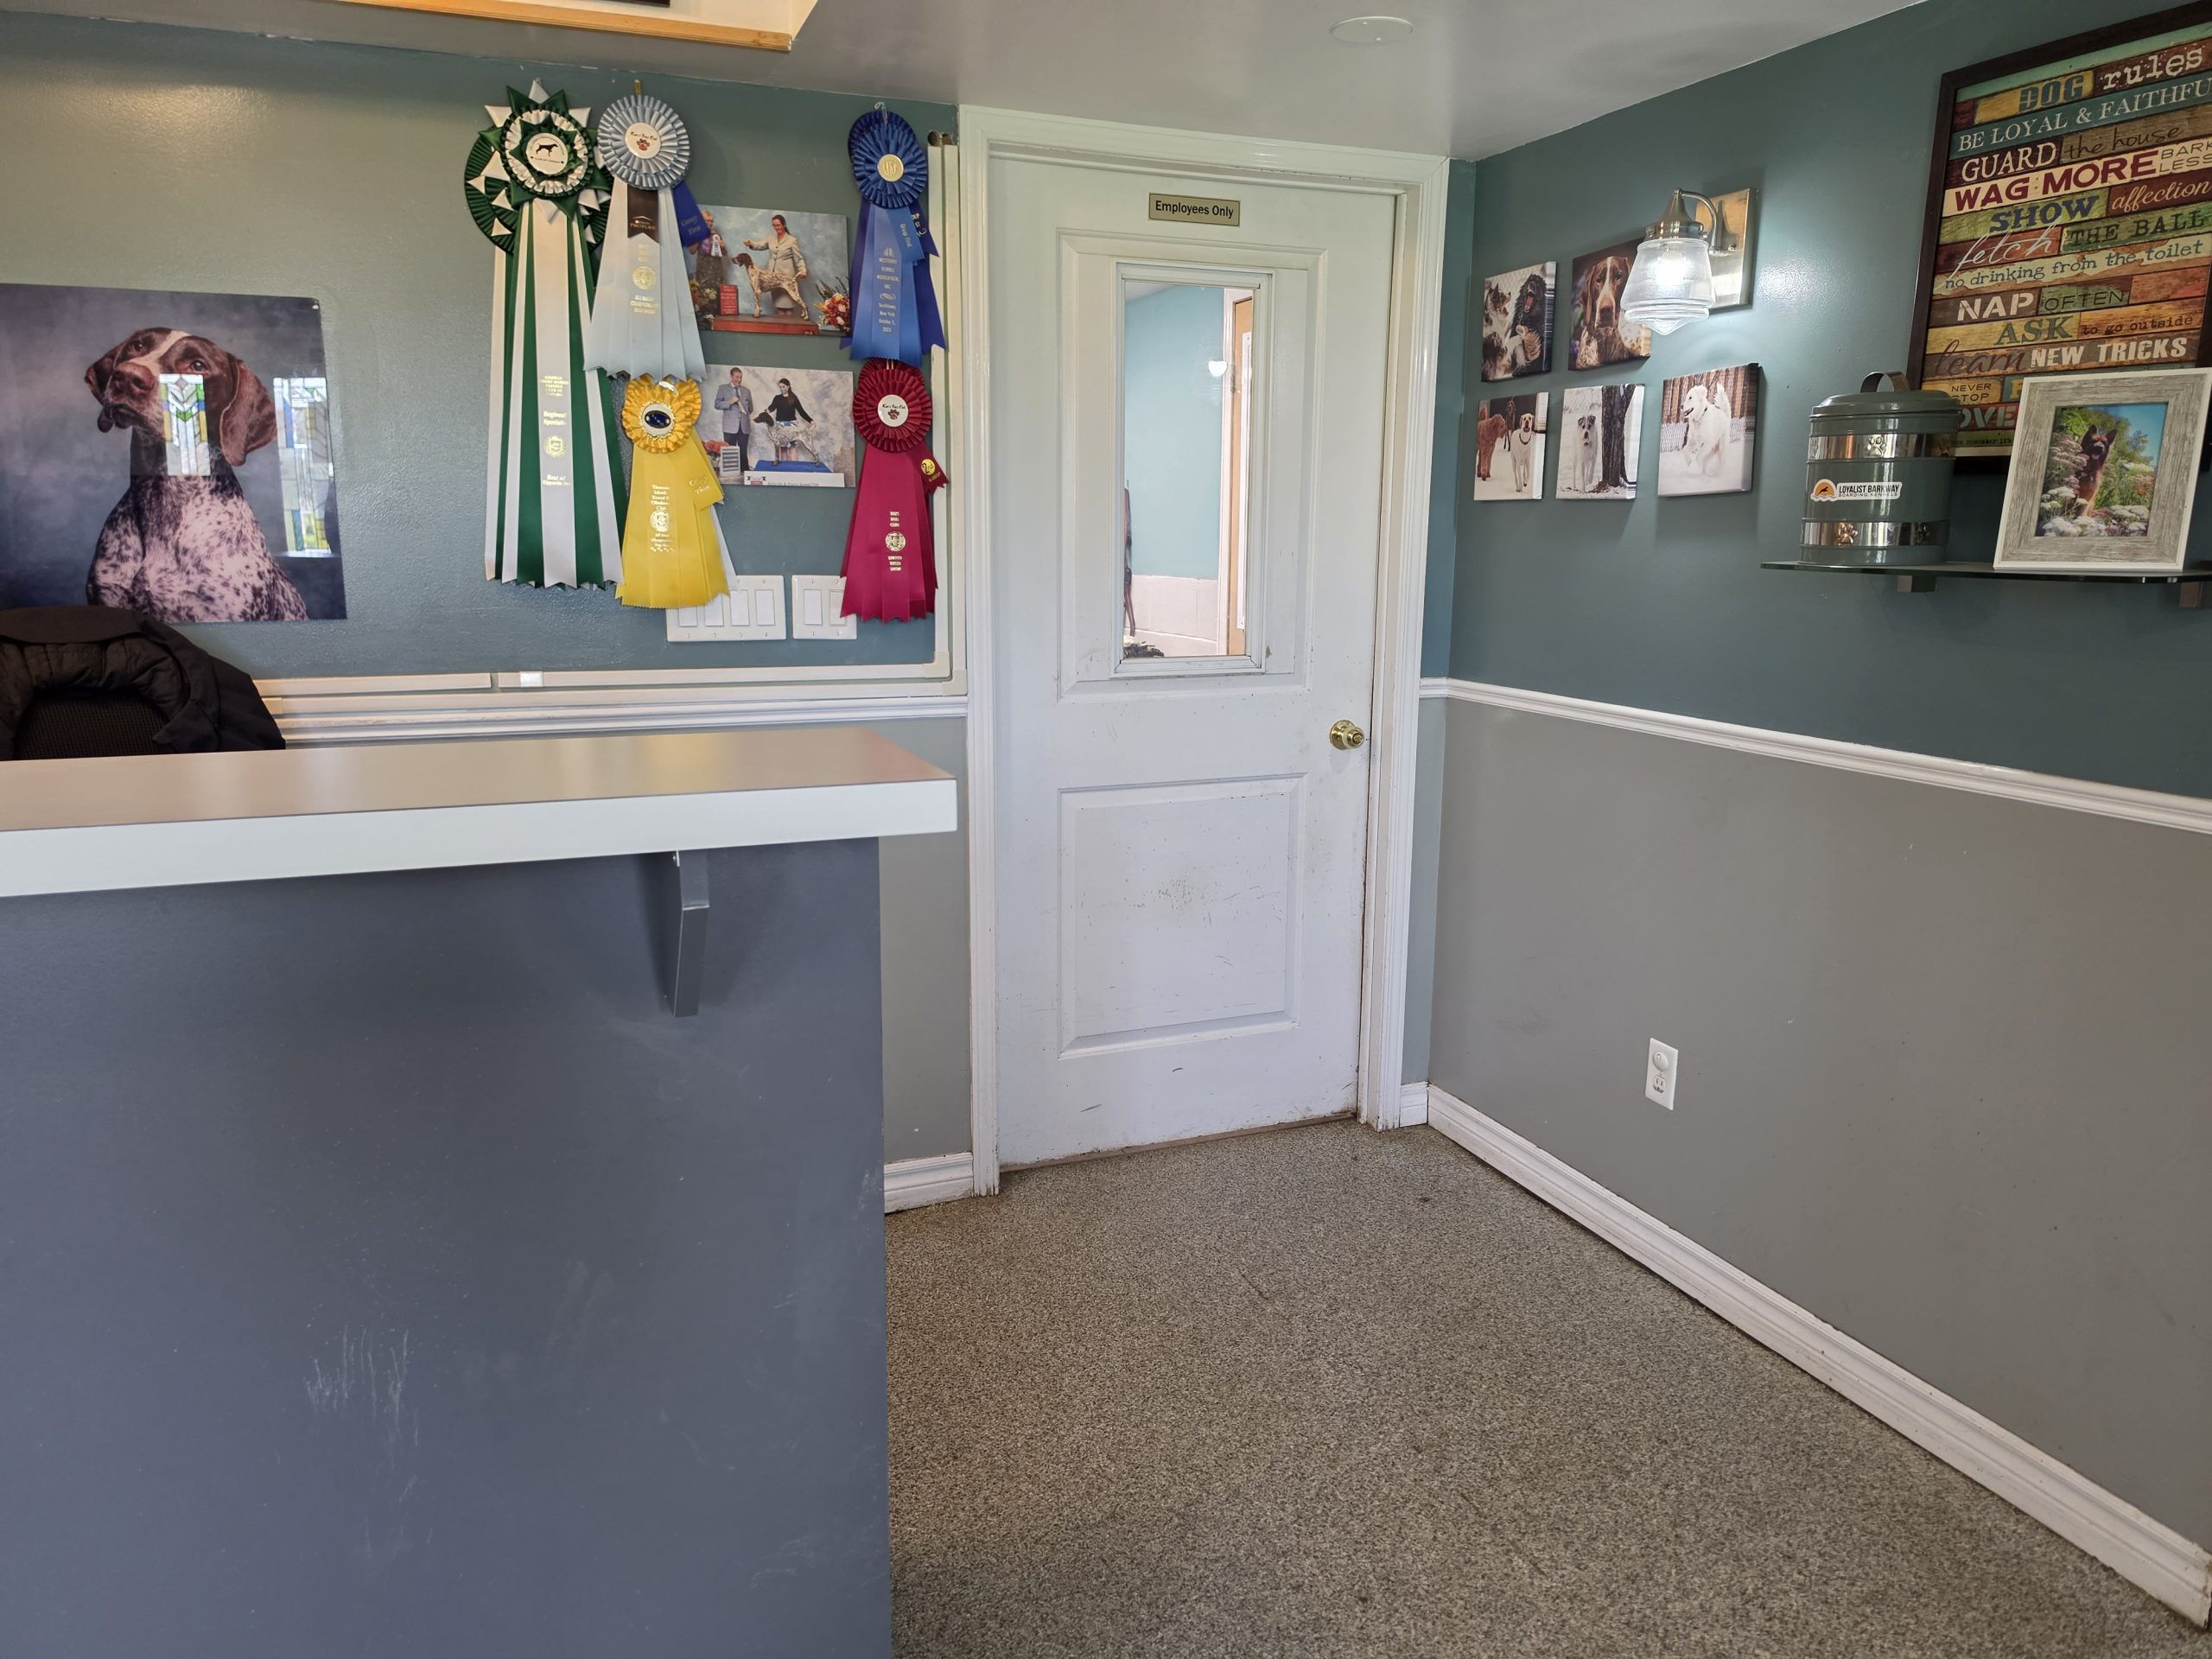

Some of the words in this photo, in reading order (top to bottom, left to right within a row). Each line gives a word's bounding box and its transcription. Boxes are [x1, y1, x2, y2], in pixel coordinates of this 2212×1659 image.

[2018, 74, 2084, 112] DOG
[2101, 47, 2203, 90] rules
[1959, 131, 1985, 152] BE
[1991, 113, 2069, 143] LOYAL
[2075, 107, 2092, 124] &
[1961, 141, 2056, 182] GUARD
[2064, 136, 2103, 162] the
[2111, 127, 2184, 151] house
[2160, 156, 2212, 173] LESS
[1955, 177, 2030, 212] WAG
[2042, 149, 2159, 197] MORE
[1155, 200, 1210, 216] Employees
[1211, 205, 1234, 219] Only
[1990, 195, 2100, 232] SHOW
[2112, 180, 2212, 213] affection
[1944, 276, 1965, 290] no
[1970, 264, 2045, 286] drinking
[2052, 258, 2098, 279] from
[2105, 246, 2138, 266] the
[2145, 238, 2203, 261] toilet
[1946, 214, 2058, 282] fetch
[2067, 219, 2120, 245] THE
[2133, 210, 2205, 238] BALL
[1957, 292, 2034, 321] NAP
[2044, 290, 2124, 312] OFTEN
[1994, 315, 2074, 346] ASK
[2082, 324, 2098, 335] to
[2105, 323, 2123, 336] go
[2129, 315, 2193, 332] outside
[1934, 339, 2027, 377] learn
[2031, 346, 2085, 368] NEW
[2097, 337, 2188, 364] TRICKS
[1951, 383, 1992, 393] NEVER
[1960, 406, 2018, 429] OVE
[1839, 485, 1866, 493] LOYALIST
